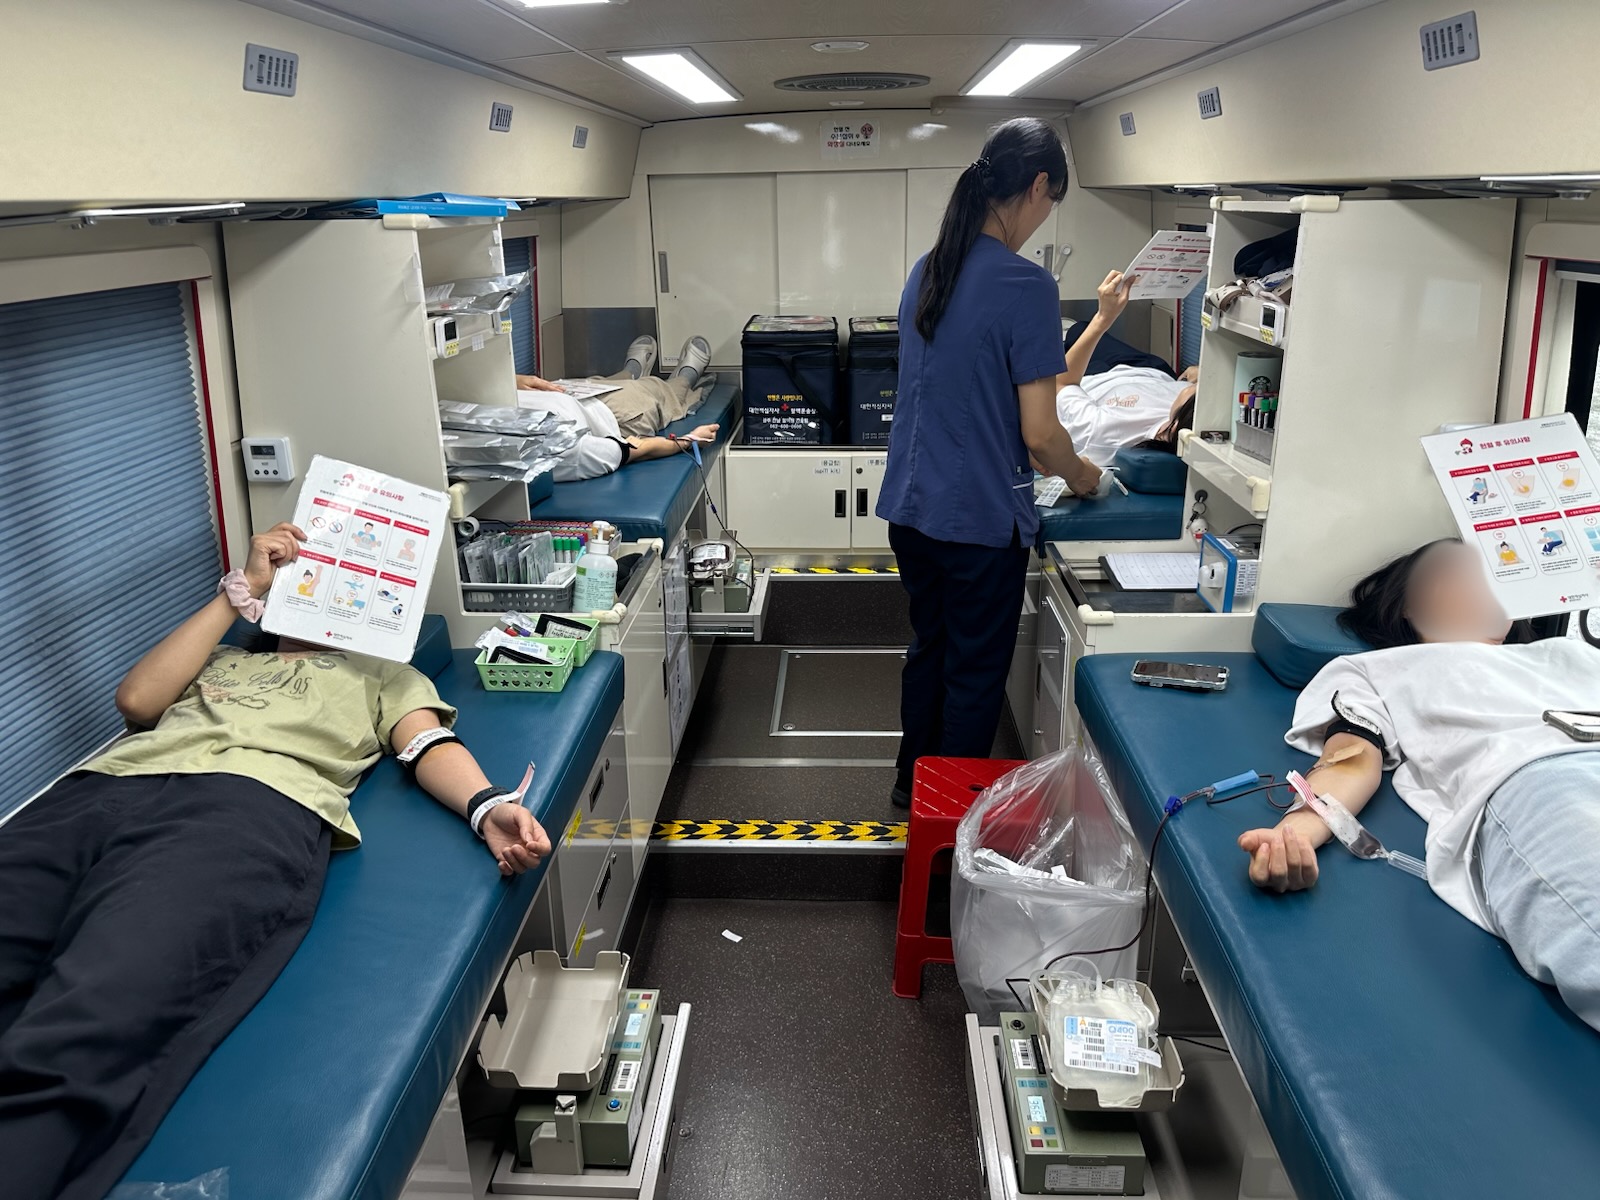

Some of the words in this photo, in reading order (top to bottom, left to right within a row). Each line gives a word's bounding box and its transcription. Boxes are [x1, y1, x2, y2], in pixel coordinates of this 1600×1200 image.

[1480, 442, 1494, 450] 헌혈
[1503, 436, 1531, 447] 유의사항
[1108, 1025, 1134, 1034] Q400
